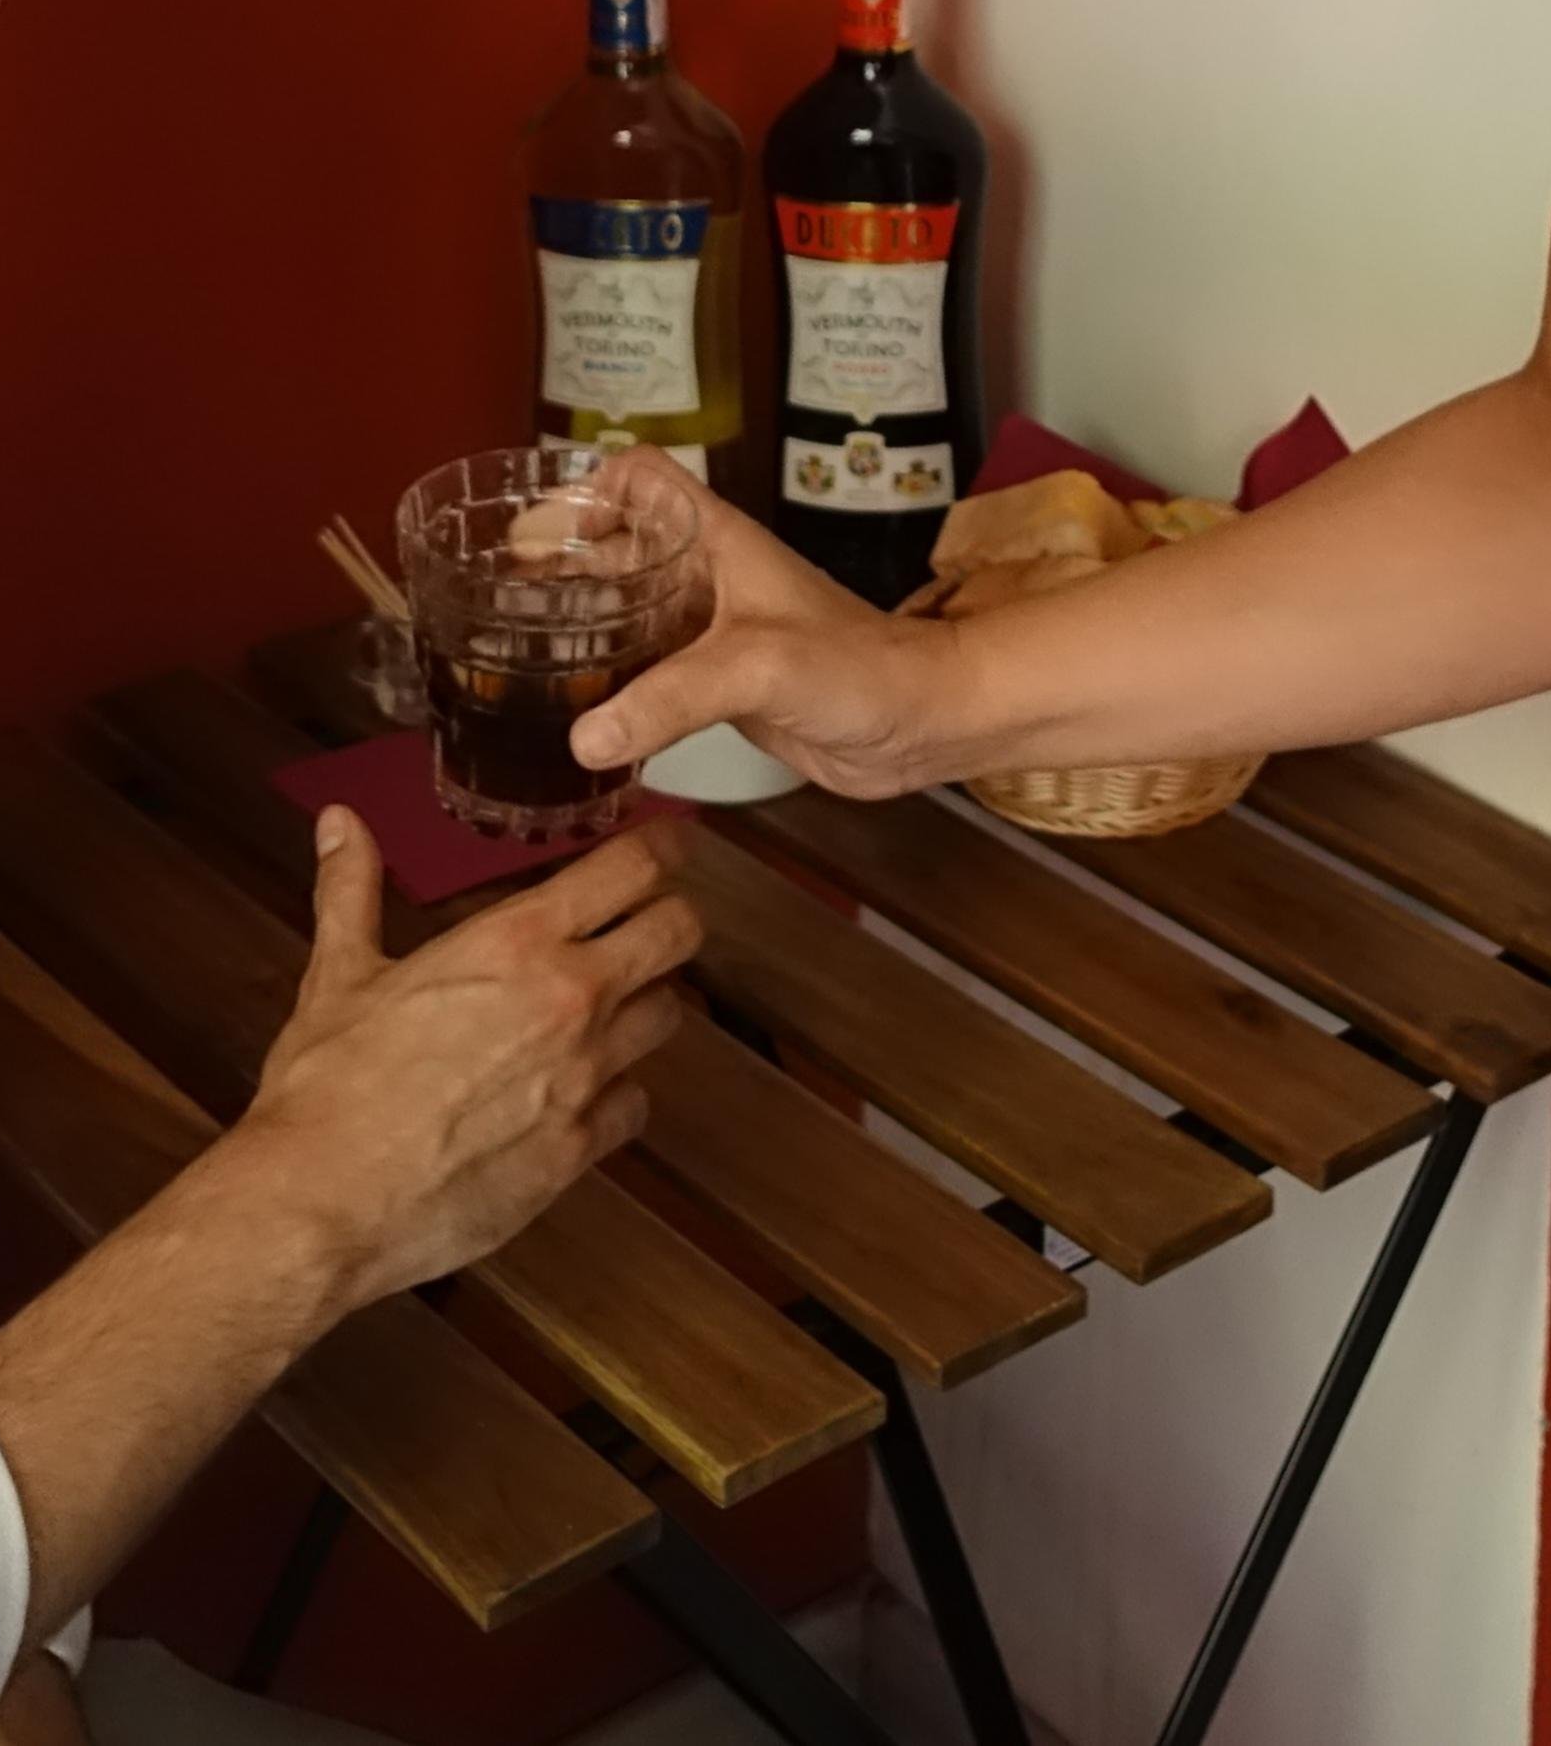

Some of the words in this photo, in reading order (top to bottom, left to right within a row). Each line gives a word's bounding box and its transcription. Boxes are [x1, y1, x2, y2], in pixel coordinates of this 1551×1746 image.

[795, 211, 934, 255] DUCATO
[559, 310, 674, 336] VERMOUTH
[809, 312, 924, 336] VERMOUTH
[574, 334, 656, 358] TORINO
[822, 338, 907, 358] TORINO
